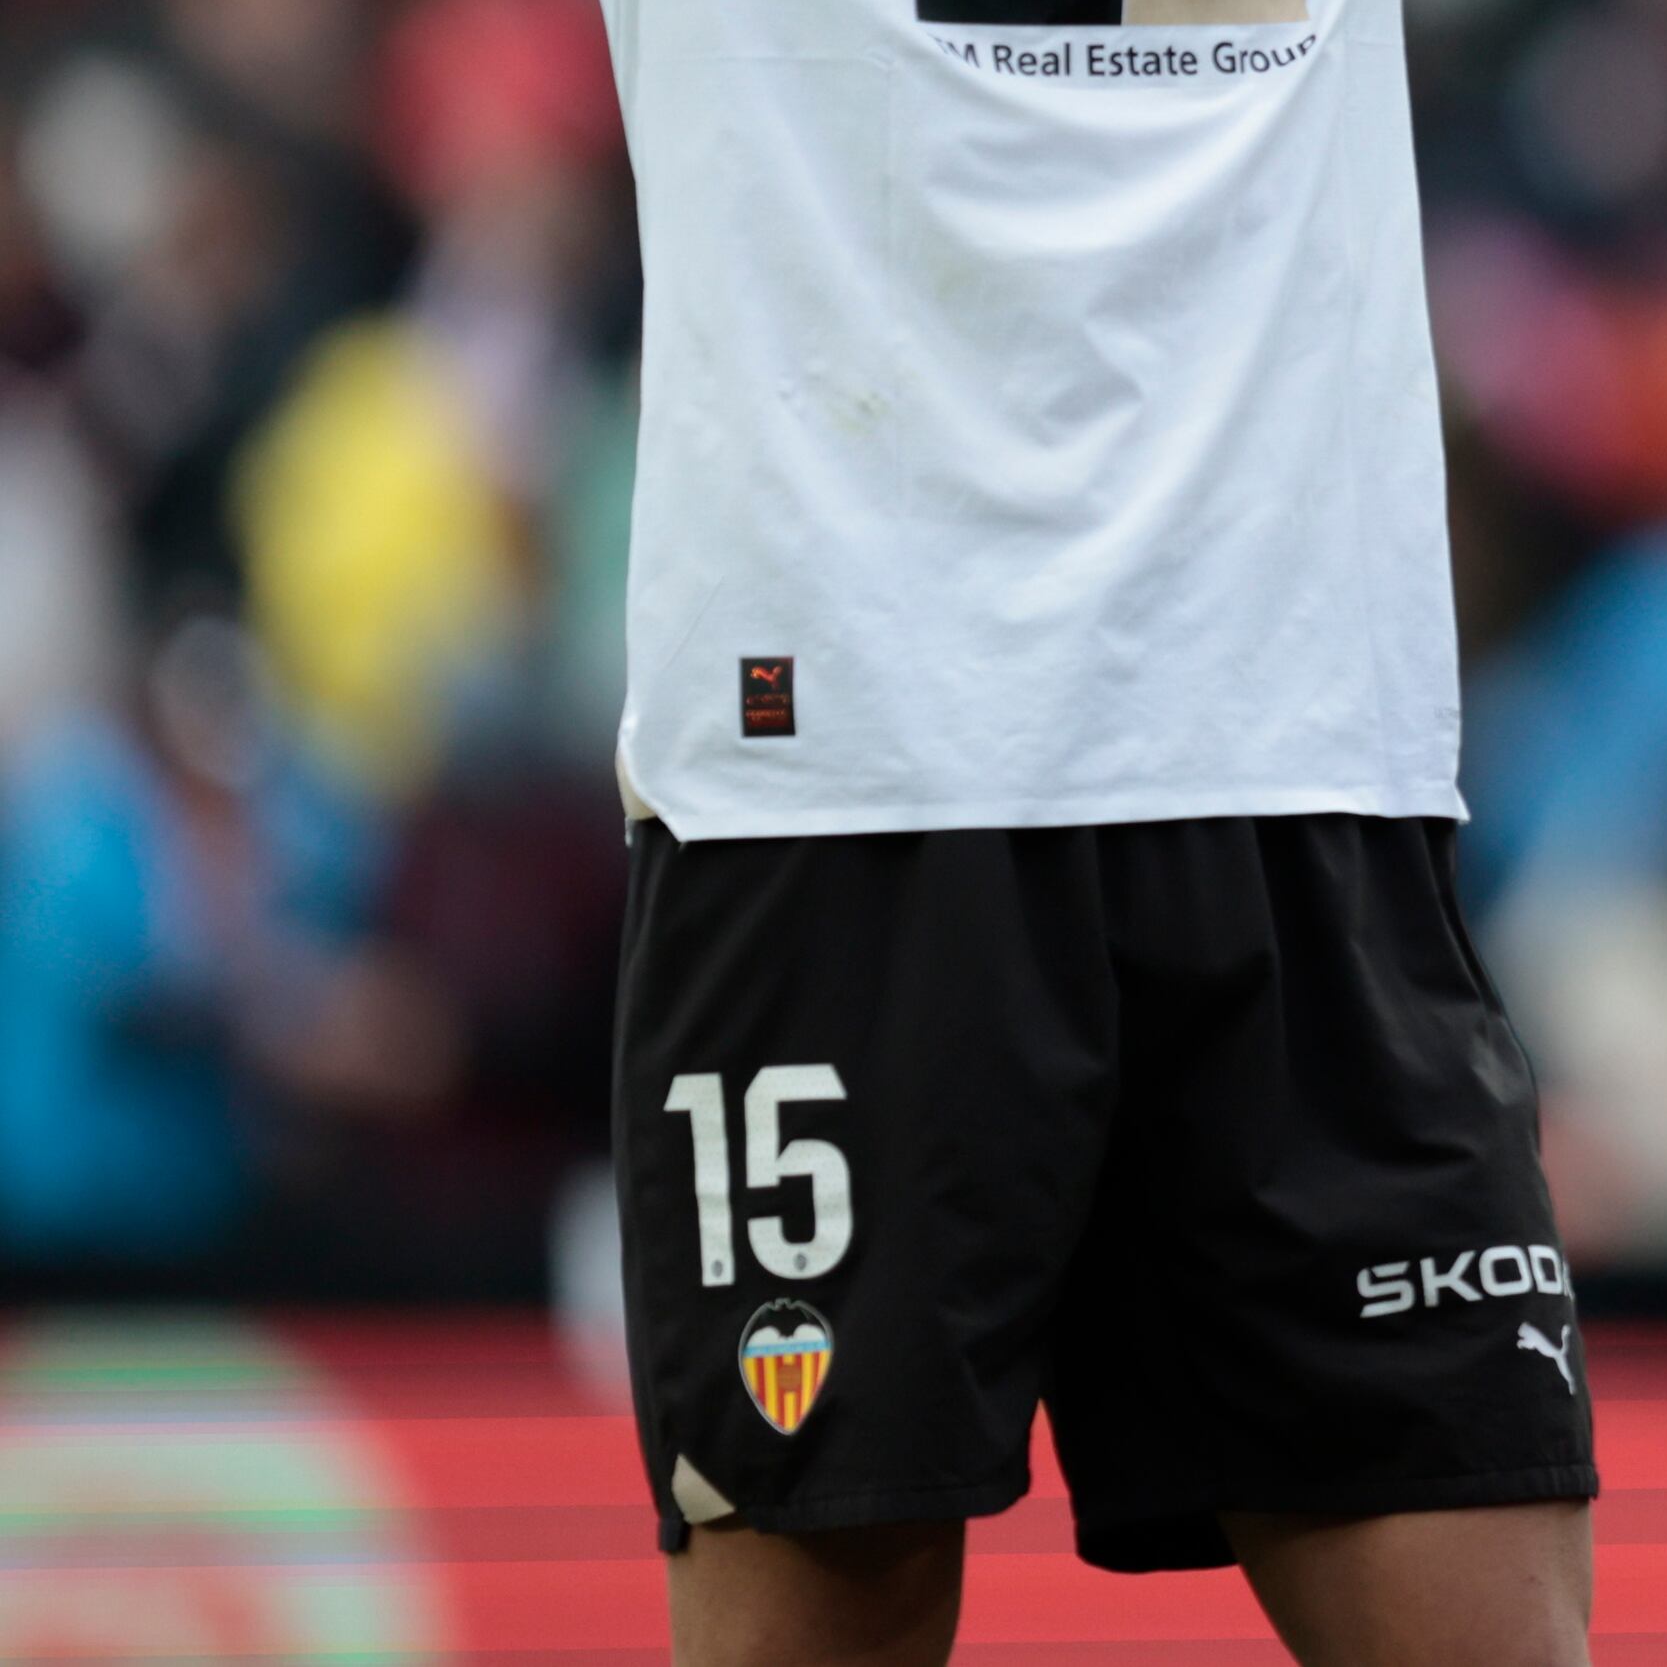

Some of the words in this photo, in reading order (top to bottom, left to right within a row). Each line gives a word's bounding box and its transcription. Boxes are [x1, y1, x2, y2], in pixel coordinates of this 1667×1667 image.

[993, 42, 1072, 77] Real
[1087, 43, 1199, 77] Estate
[1212, 33, 1318, 75] Group
[664, 1064, 853, 1288] 15
